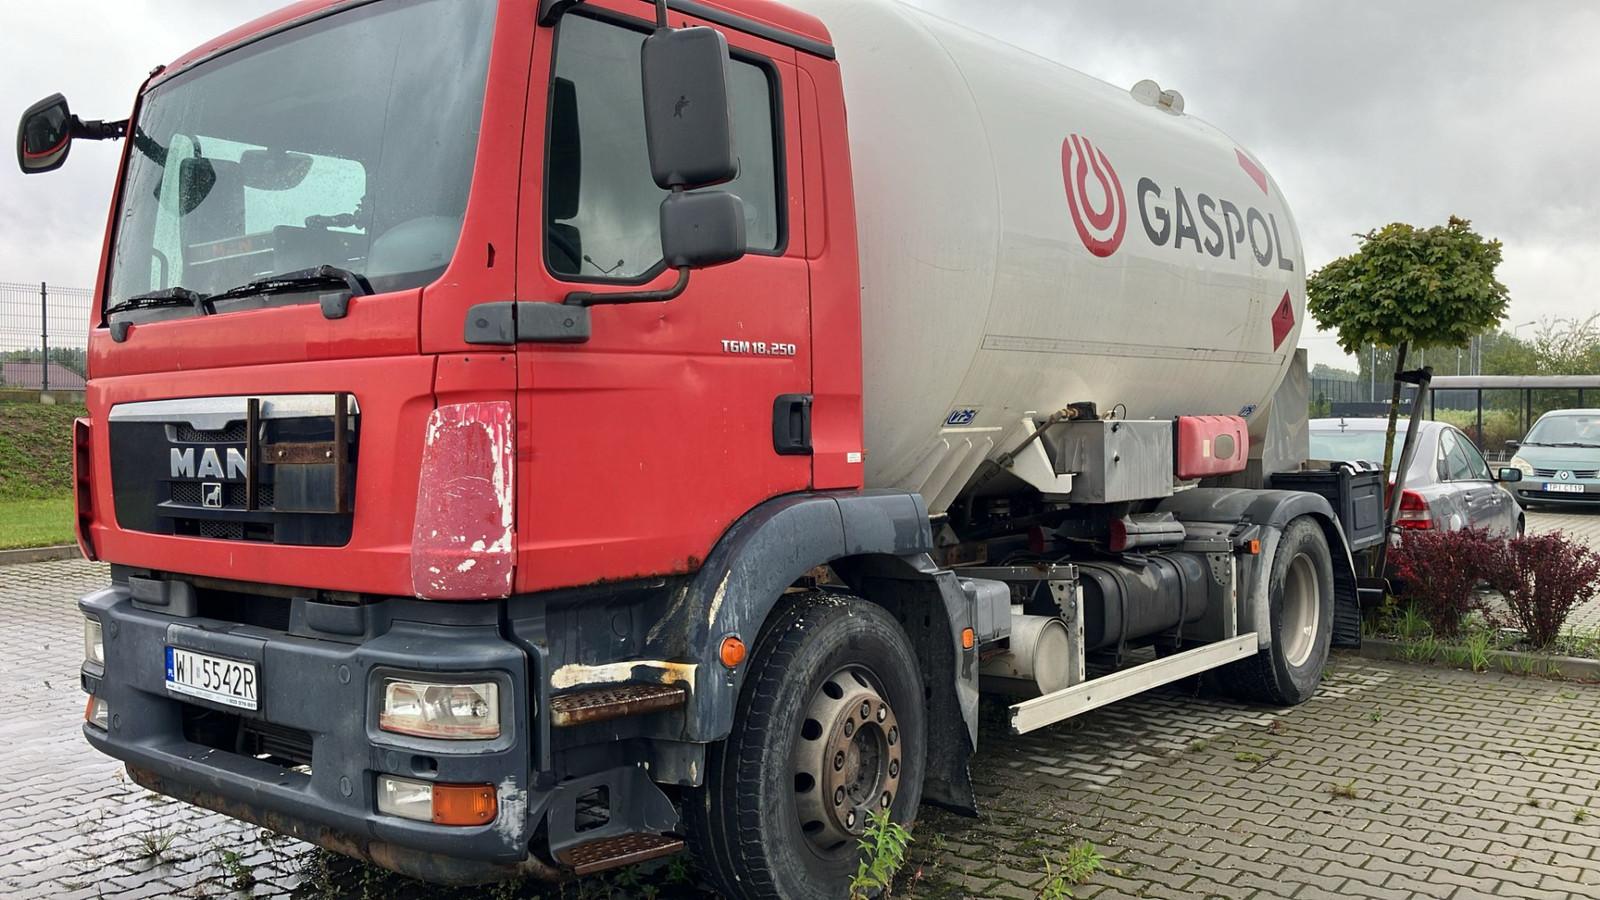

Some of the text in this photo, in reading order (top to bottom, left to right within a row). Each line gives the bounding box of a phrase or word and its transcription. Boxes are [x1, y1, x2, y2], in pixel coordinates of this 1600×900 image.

[1137, 176, 1294, 272] GASPOL
[721, 339, 796, 356] TGM 18.250
[170, 447, 248, 479] MAN
[175, 652, 193, 685] WI
[203, 659, 254, 699] 5542R
